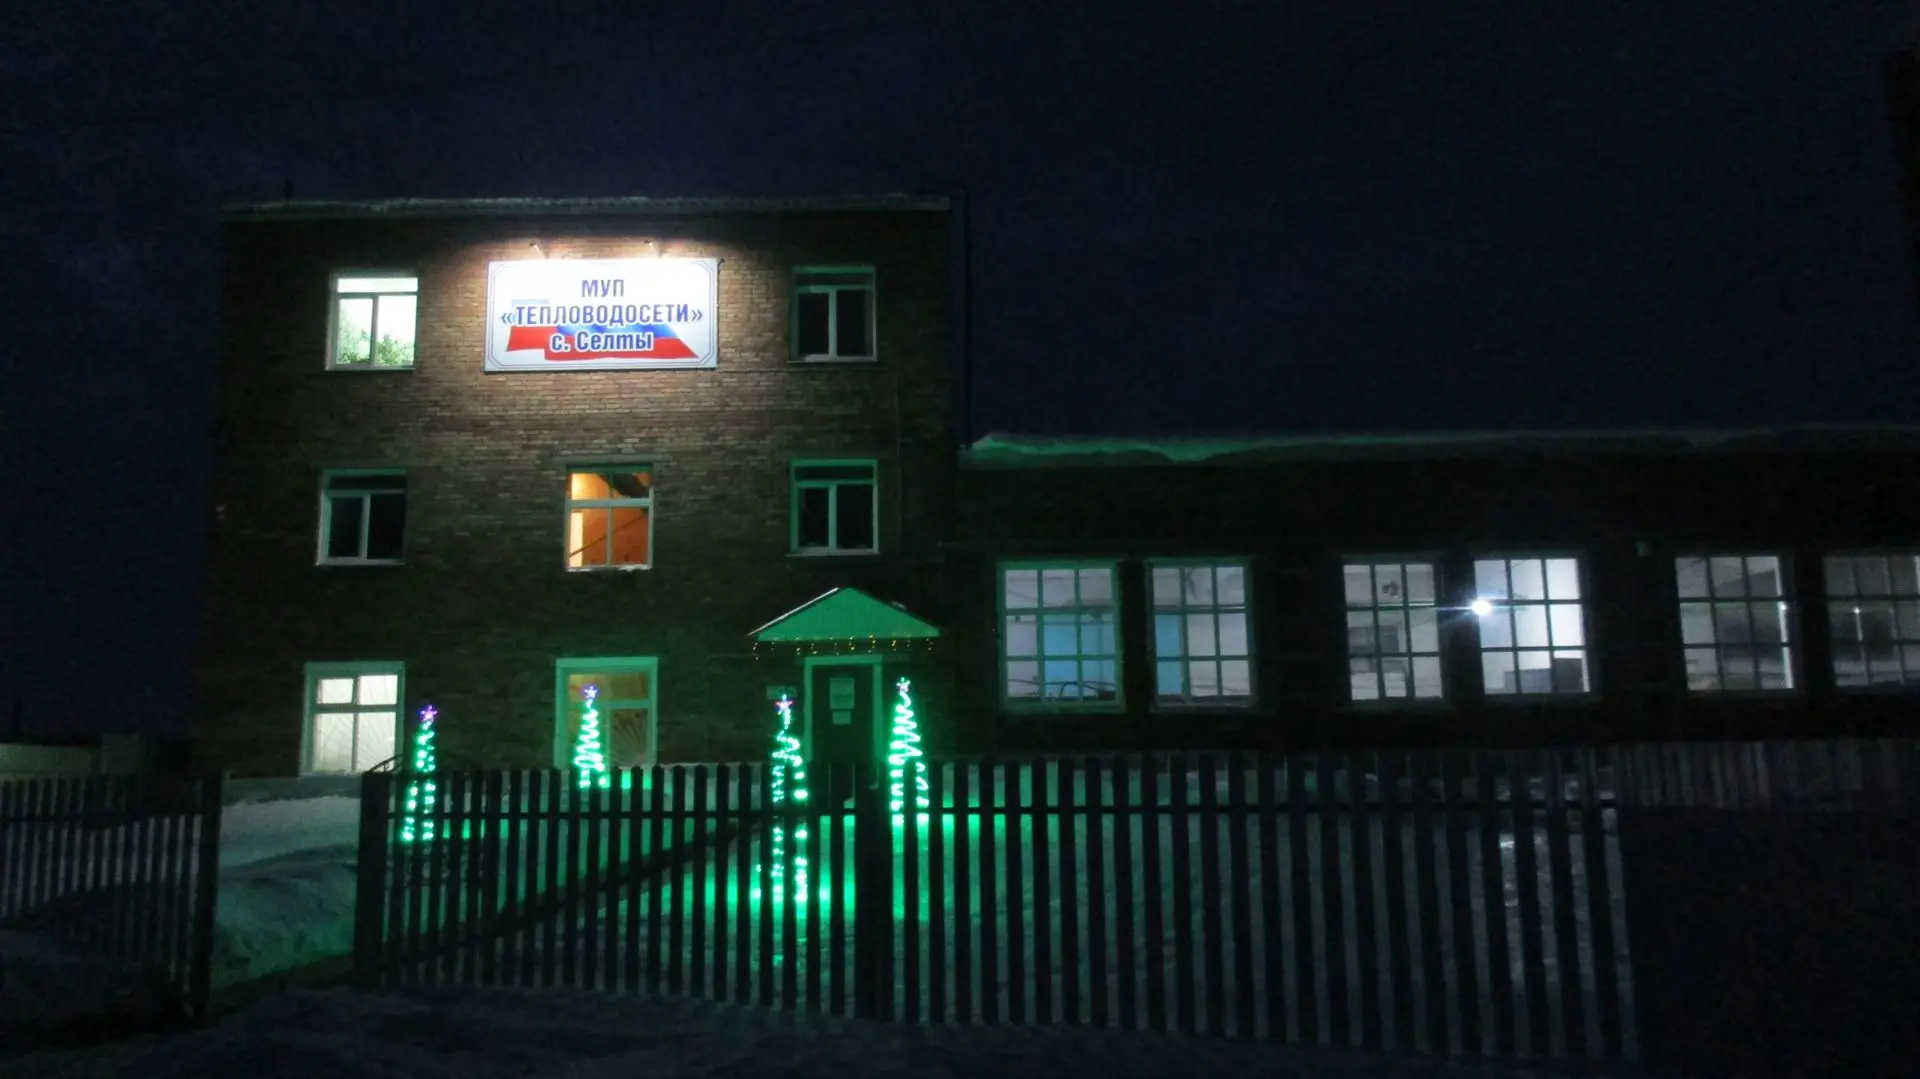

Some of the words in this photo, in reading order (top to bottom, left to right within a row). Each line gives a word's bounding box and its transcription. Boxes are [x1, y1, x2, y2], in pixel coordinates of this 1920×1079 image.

[582, 279, 625, 297] МУП
[501, 303, 703, 326] «ТЕПЛОВОДОСЕТИ»
[551, 334, 569, 350] с.
[576, 331, 652, 351] Селты
